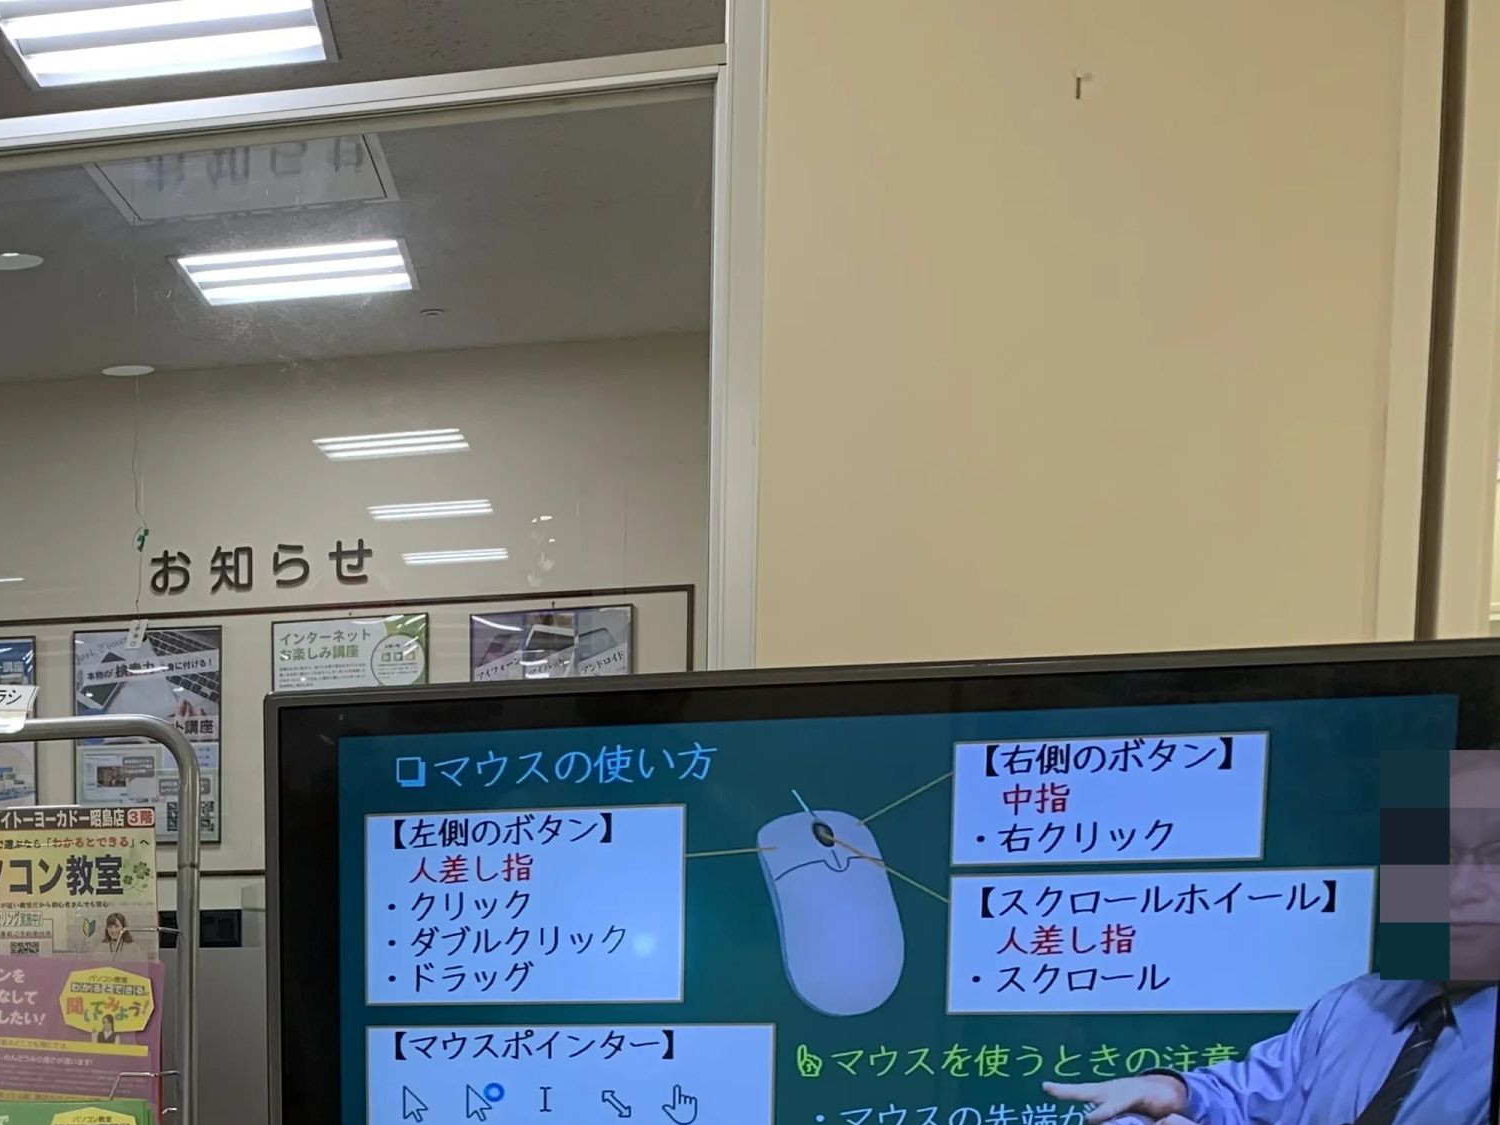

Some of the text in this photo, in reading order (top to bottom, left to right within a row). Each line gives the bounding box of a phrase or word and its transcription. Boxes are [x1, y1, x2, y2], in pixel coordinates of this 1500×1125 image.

[150, 538, 373, 595] お知らせ
[279, 628, 371, 646] インターネット
[433, 741, 718, 788] マウスの使い方
[985, 736, 1234, 777] 【右側のボタン】
[1001, 781, 1070, 816] 中指
[0, 809, 125, 828] イトーヨーカドー昭島店
[393, 811, 613, 850] 【左側のボタン】
[409, 852, 535, 885] 人差し指
[980, 879, 1338, 920] 【スクロールホイール】
[996, 924, 1137, 957] 人差し指
[393, 1028, 676, 1062] 【マウスポインター】
